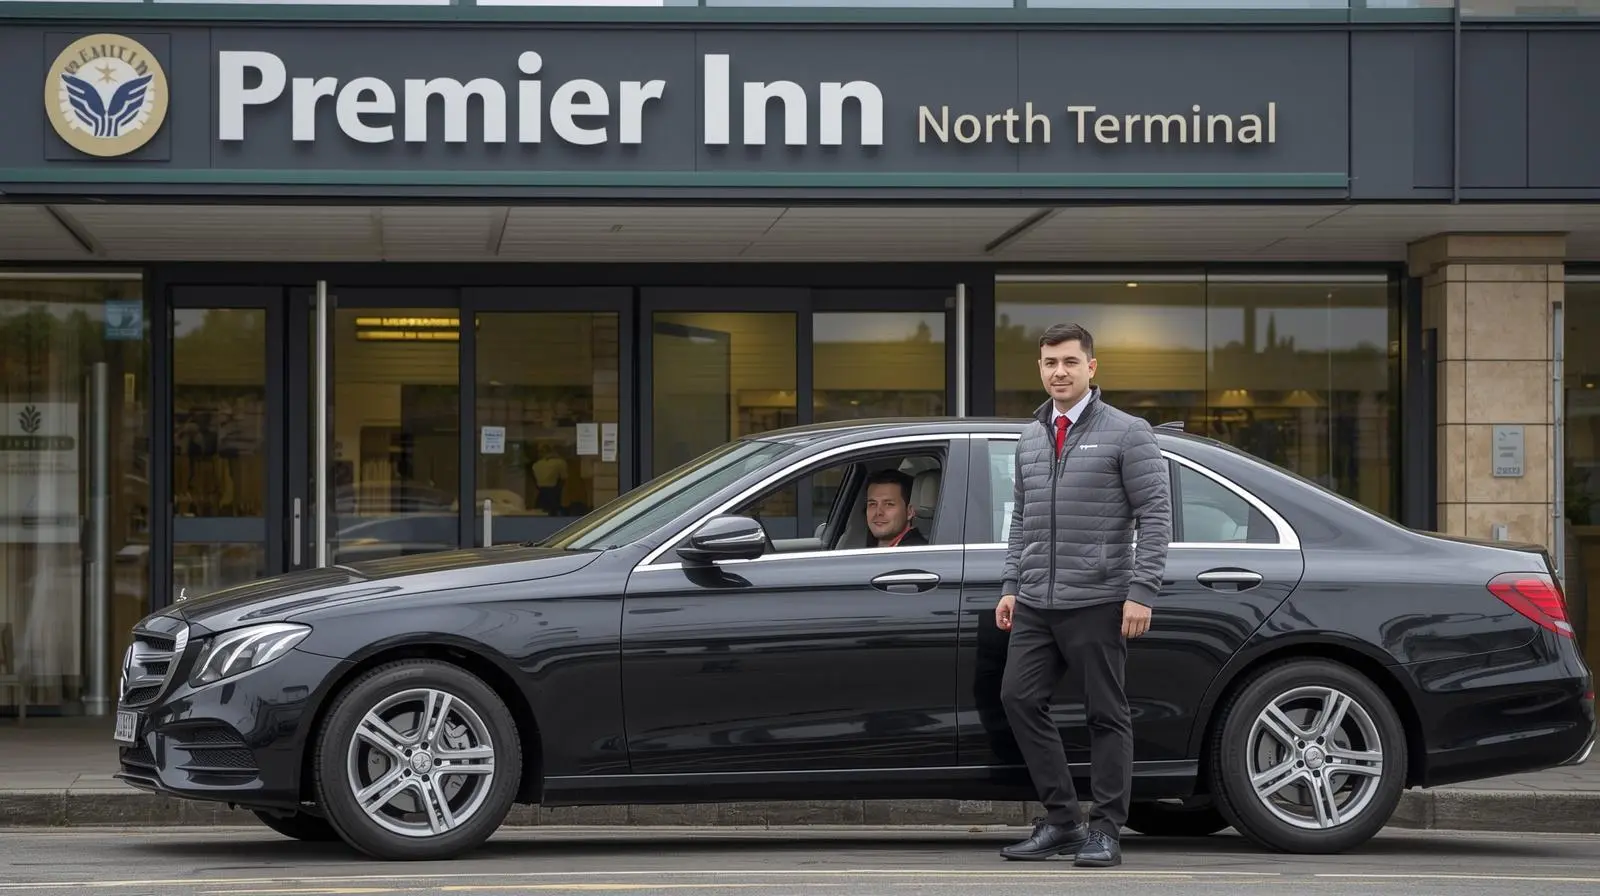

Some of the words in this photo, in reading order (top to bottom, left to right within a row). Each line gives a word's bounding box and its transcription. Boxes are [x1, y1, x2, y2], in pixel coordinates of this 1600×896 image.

[218, 50, 667, 145] Premier
[703, 53, 884, 147] Inn
[918, 101, 1051, 144] North
[1067, 101, 1277, 144] Terminal
